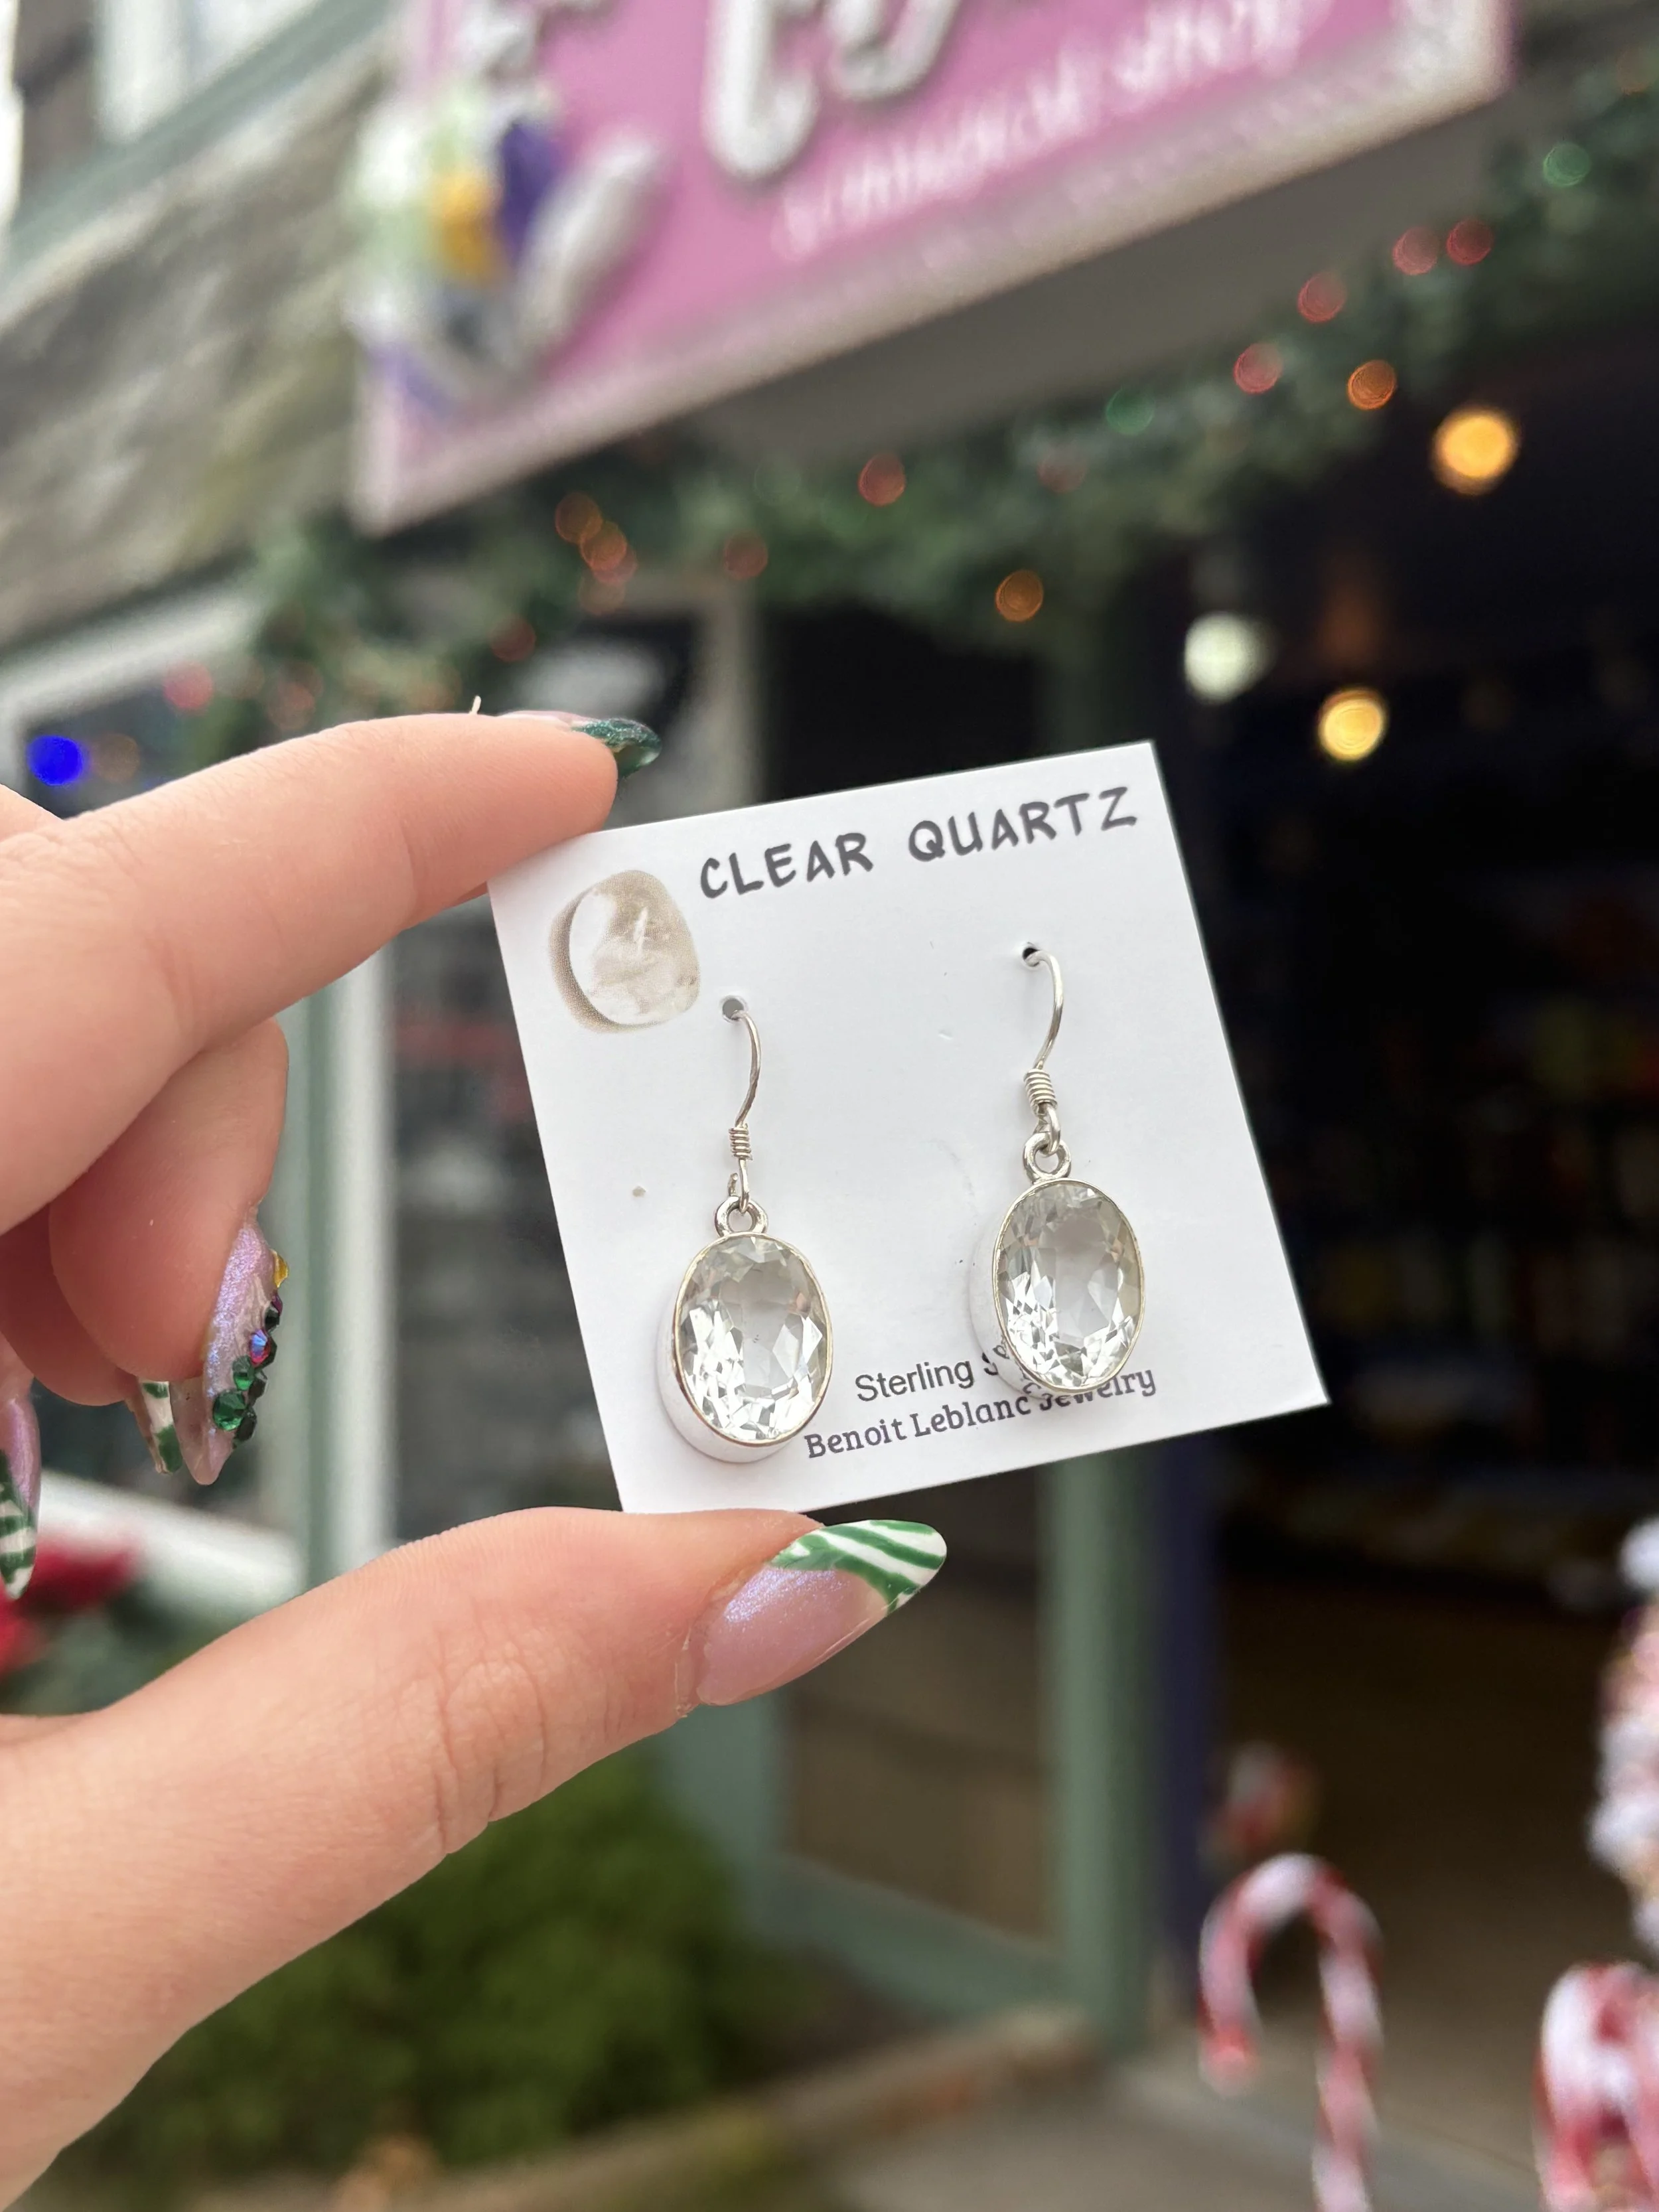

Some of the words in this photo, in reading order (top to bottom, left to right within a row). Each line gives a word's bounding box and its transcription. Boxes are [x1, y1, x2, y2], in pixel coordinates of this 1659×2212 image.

[701, 832, 874, 899] CLEAR
[908, 786, 1137, 862] QUARTZ
[855, 1361, 975, 1402] Sterling
[804, 1419, 908, 1459] Benoit
[908, 1390, 1033, 1438] Leblanc
